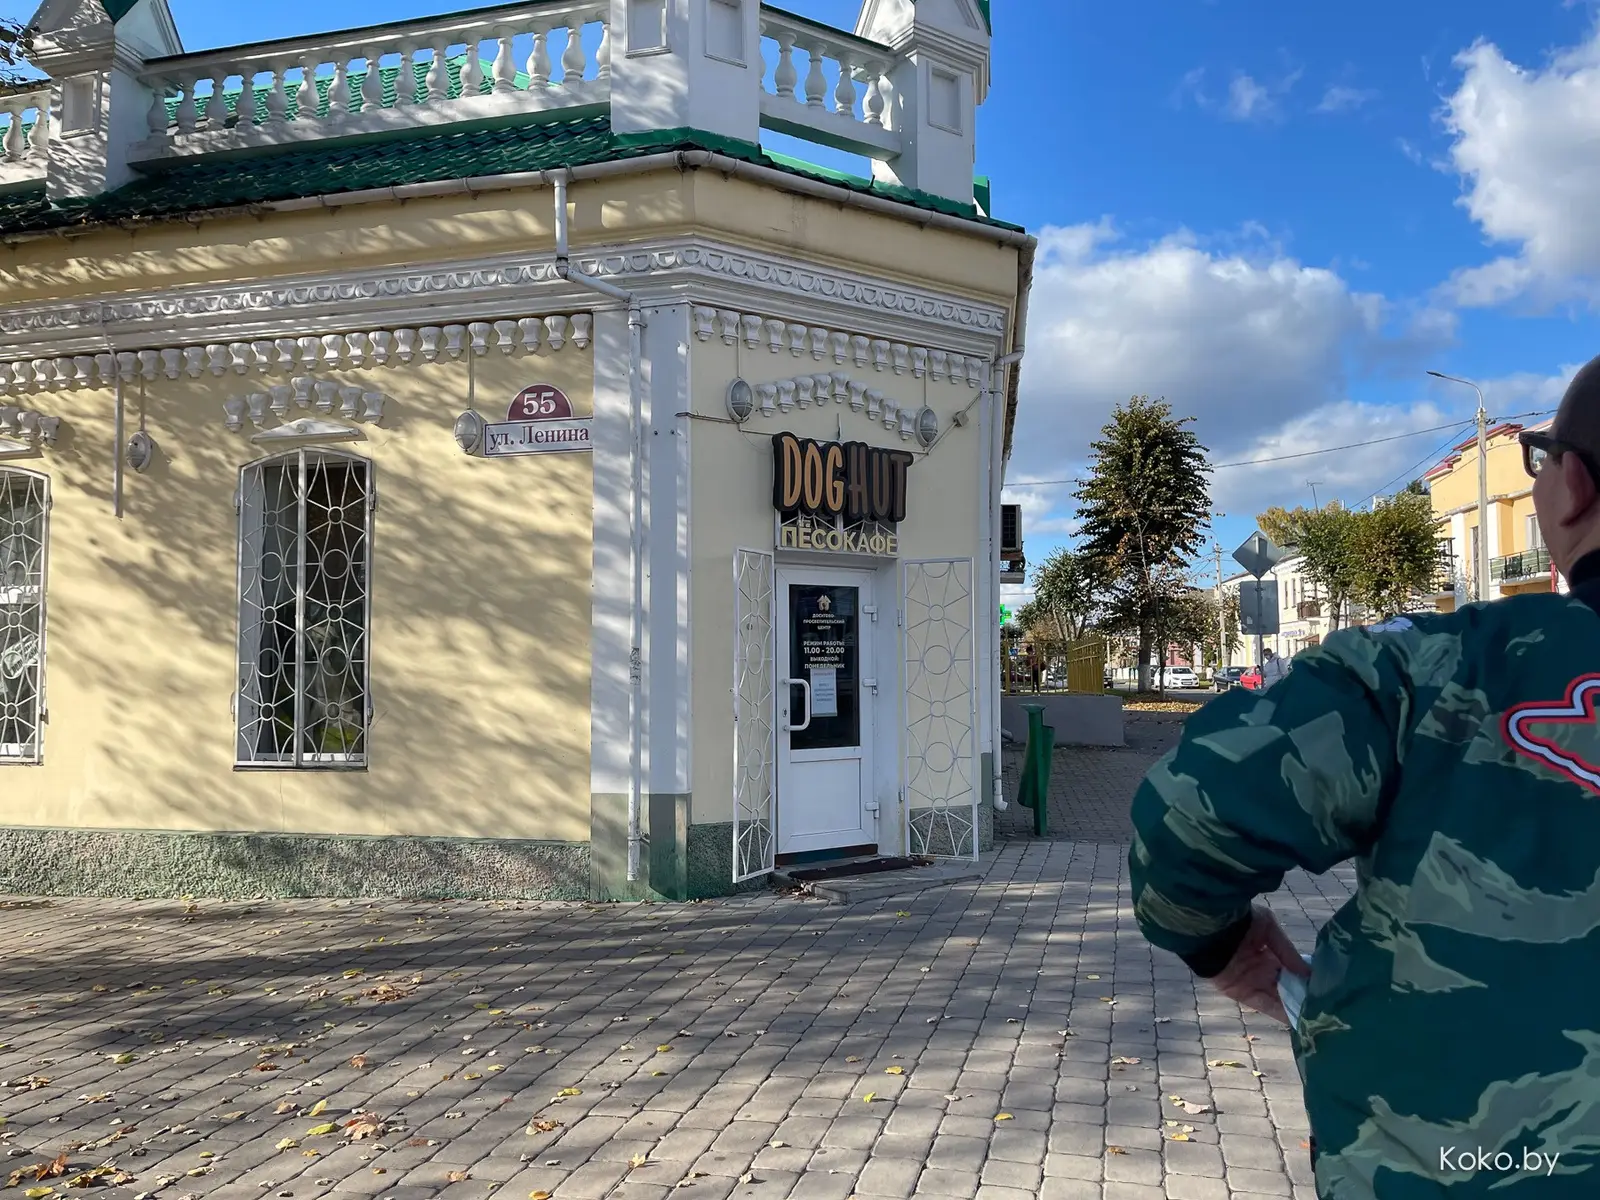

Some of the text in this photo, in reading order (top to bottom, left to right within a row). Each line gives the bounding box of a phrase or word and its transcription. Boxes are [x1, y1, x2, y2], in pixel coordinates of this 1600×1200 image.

[522, 391, 556, 415] 55
[489, 425, 589, 450] ул. Ленина
[777, 433, 913, 519] DOG HUT
[780, 518, 898, 556] ПЁСОКАФЕ
